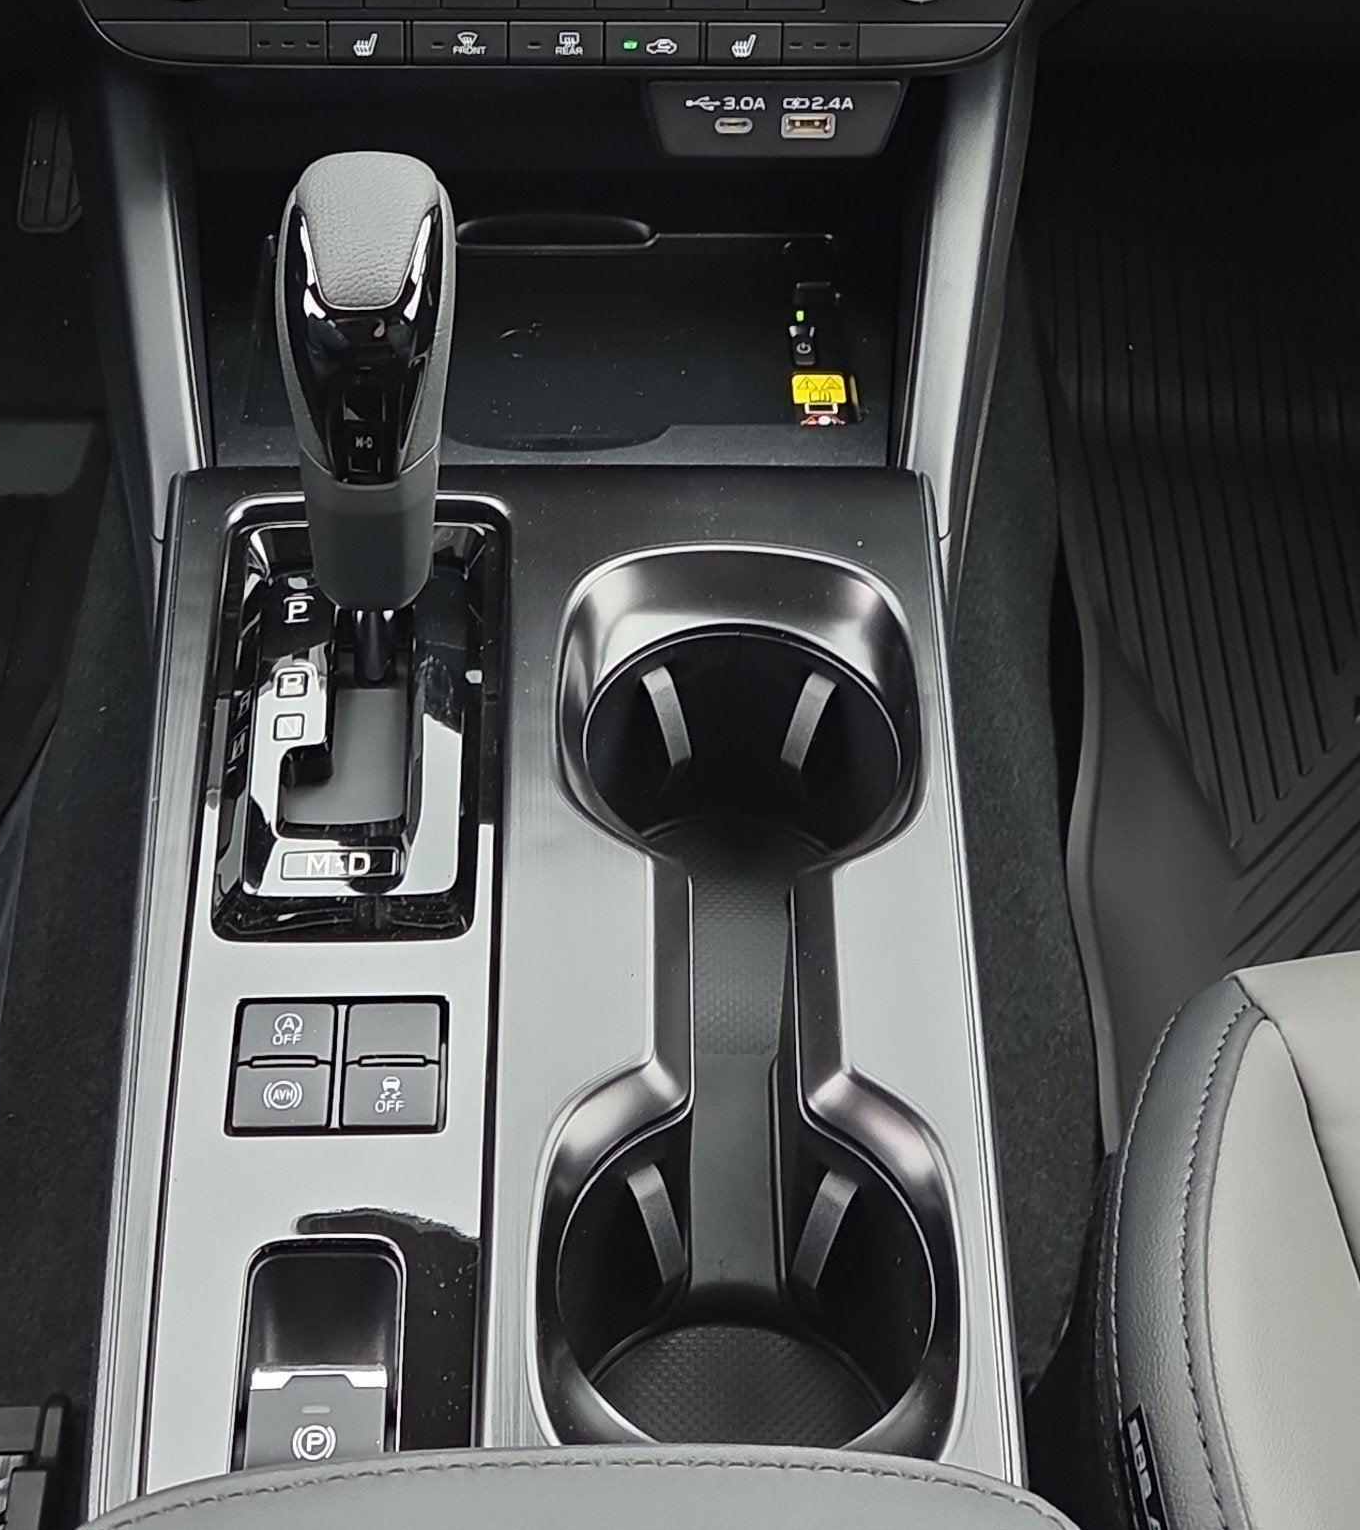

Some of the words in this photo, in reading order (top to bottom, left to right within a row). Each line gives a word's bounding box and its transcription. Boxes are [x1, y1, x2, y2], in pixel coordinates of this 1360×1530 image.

[554, 45, 584, 56] REAR
[722, 96, 766, 111] 3.0A
[811, 96, 854, 111] 2.4A
[287, 600, 308, 621] P
[272, 1033, 303, 1046] OFF
[272, 1088, 294, 1101] AVH
[374, 1099, 405, 1114] OFF
